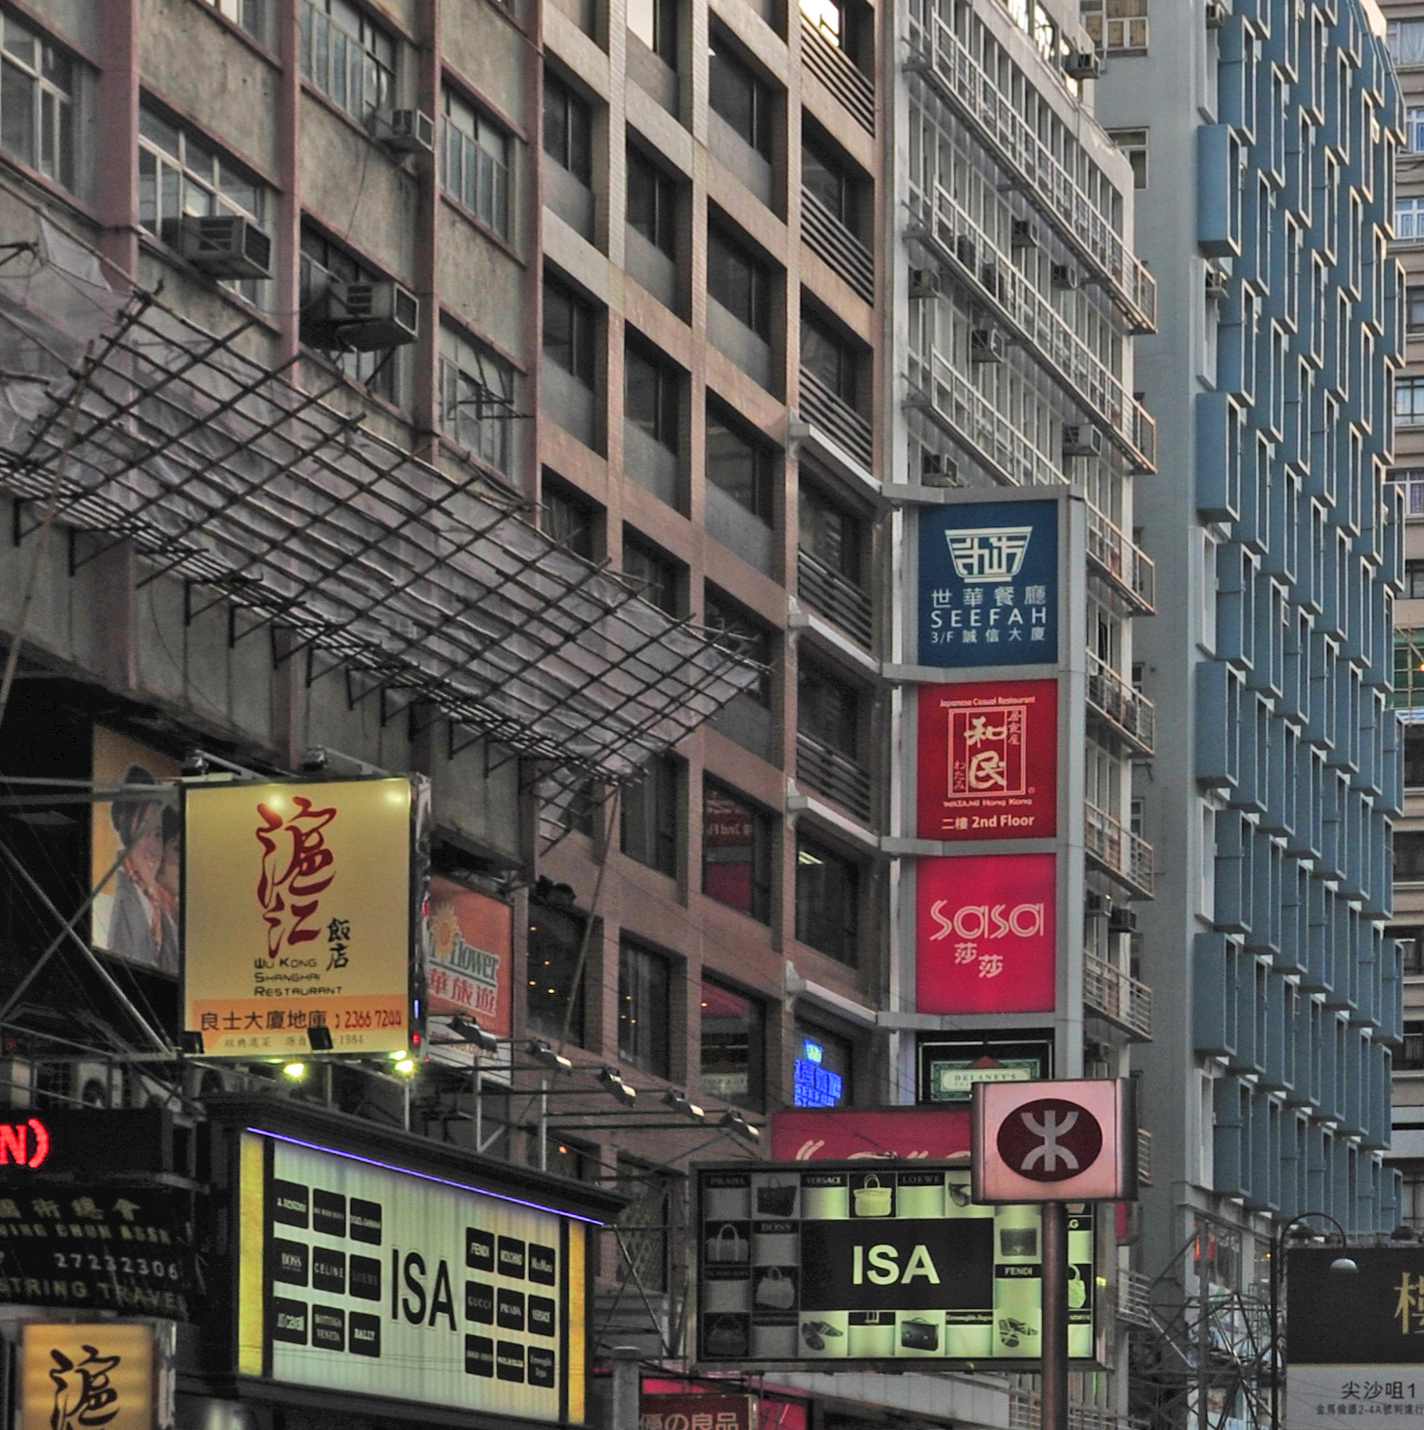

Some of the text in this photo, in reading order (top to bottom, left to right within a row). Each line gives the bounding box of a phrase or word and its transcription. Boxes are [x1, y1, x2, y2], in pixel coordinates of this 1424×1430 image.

[931, 585, 1047, 608] 世華餐廳
[931, 607, 1047, 628] SEEFAH
[931, 627, 1046, 644] 3/F 誠信大廈
[940, 699, 972, 708] Japanese
[998, 696, 1036, 704] Restaurant
[964, 716, 1008, 789] 和民
[943, 797, 1033, 807] WATAMI Hong Kong
[972, 815, 998, 828] 2nd
[1000, 814, 1035, 827] Floor
[326, 917, 351, 972] 飯店
[954, 942, 1003, 978] 莎莎
[344, 1011, 372, 1029] 2366
[54, 1252, 179, 1281] 27232306
[314, 1263, 343, 1278] CELINE
[853, 1245, 941, 1284] ISA
[1005, 1266, 1033, 1275] FENDI
[392, 1248, 458, 1332] ISA
[1341, 1381, 1416, 1399] 尖沙咀1
